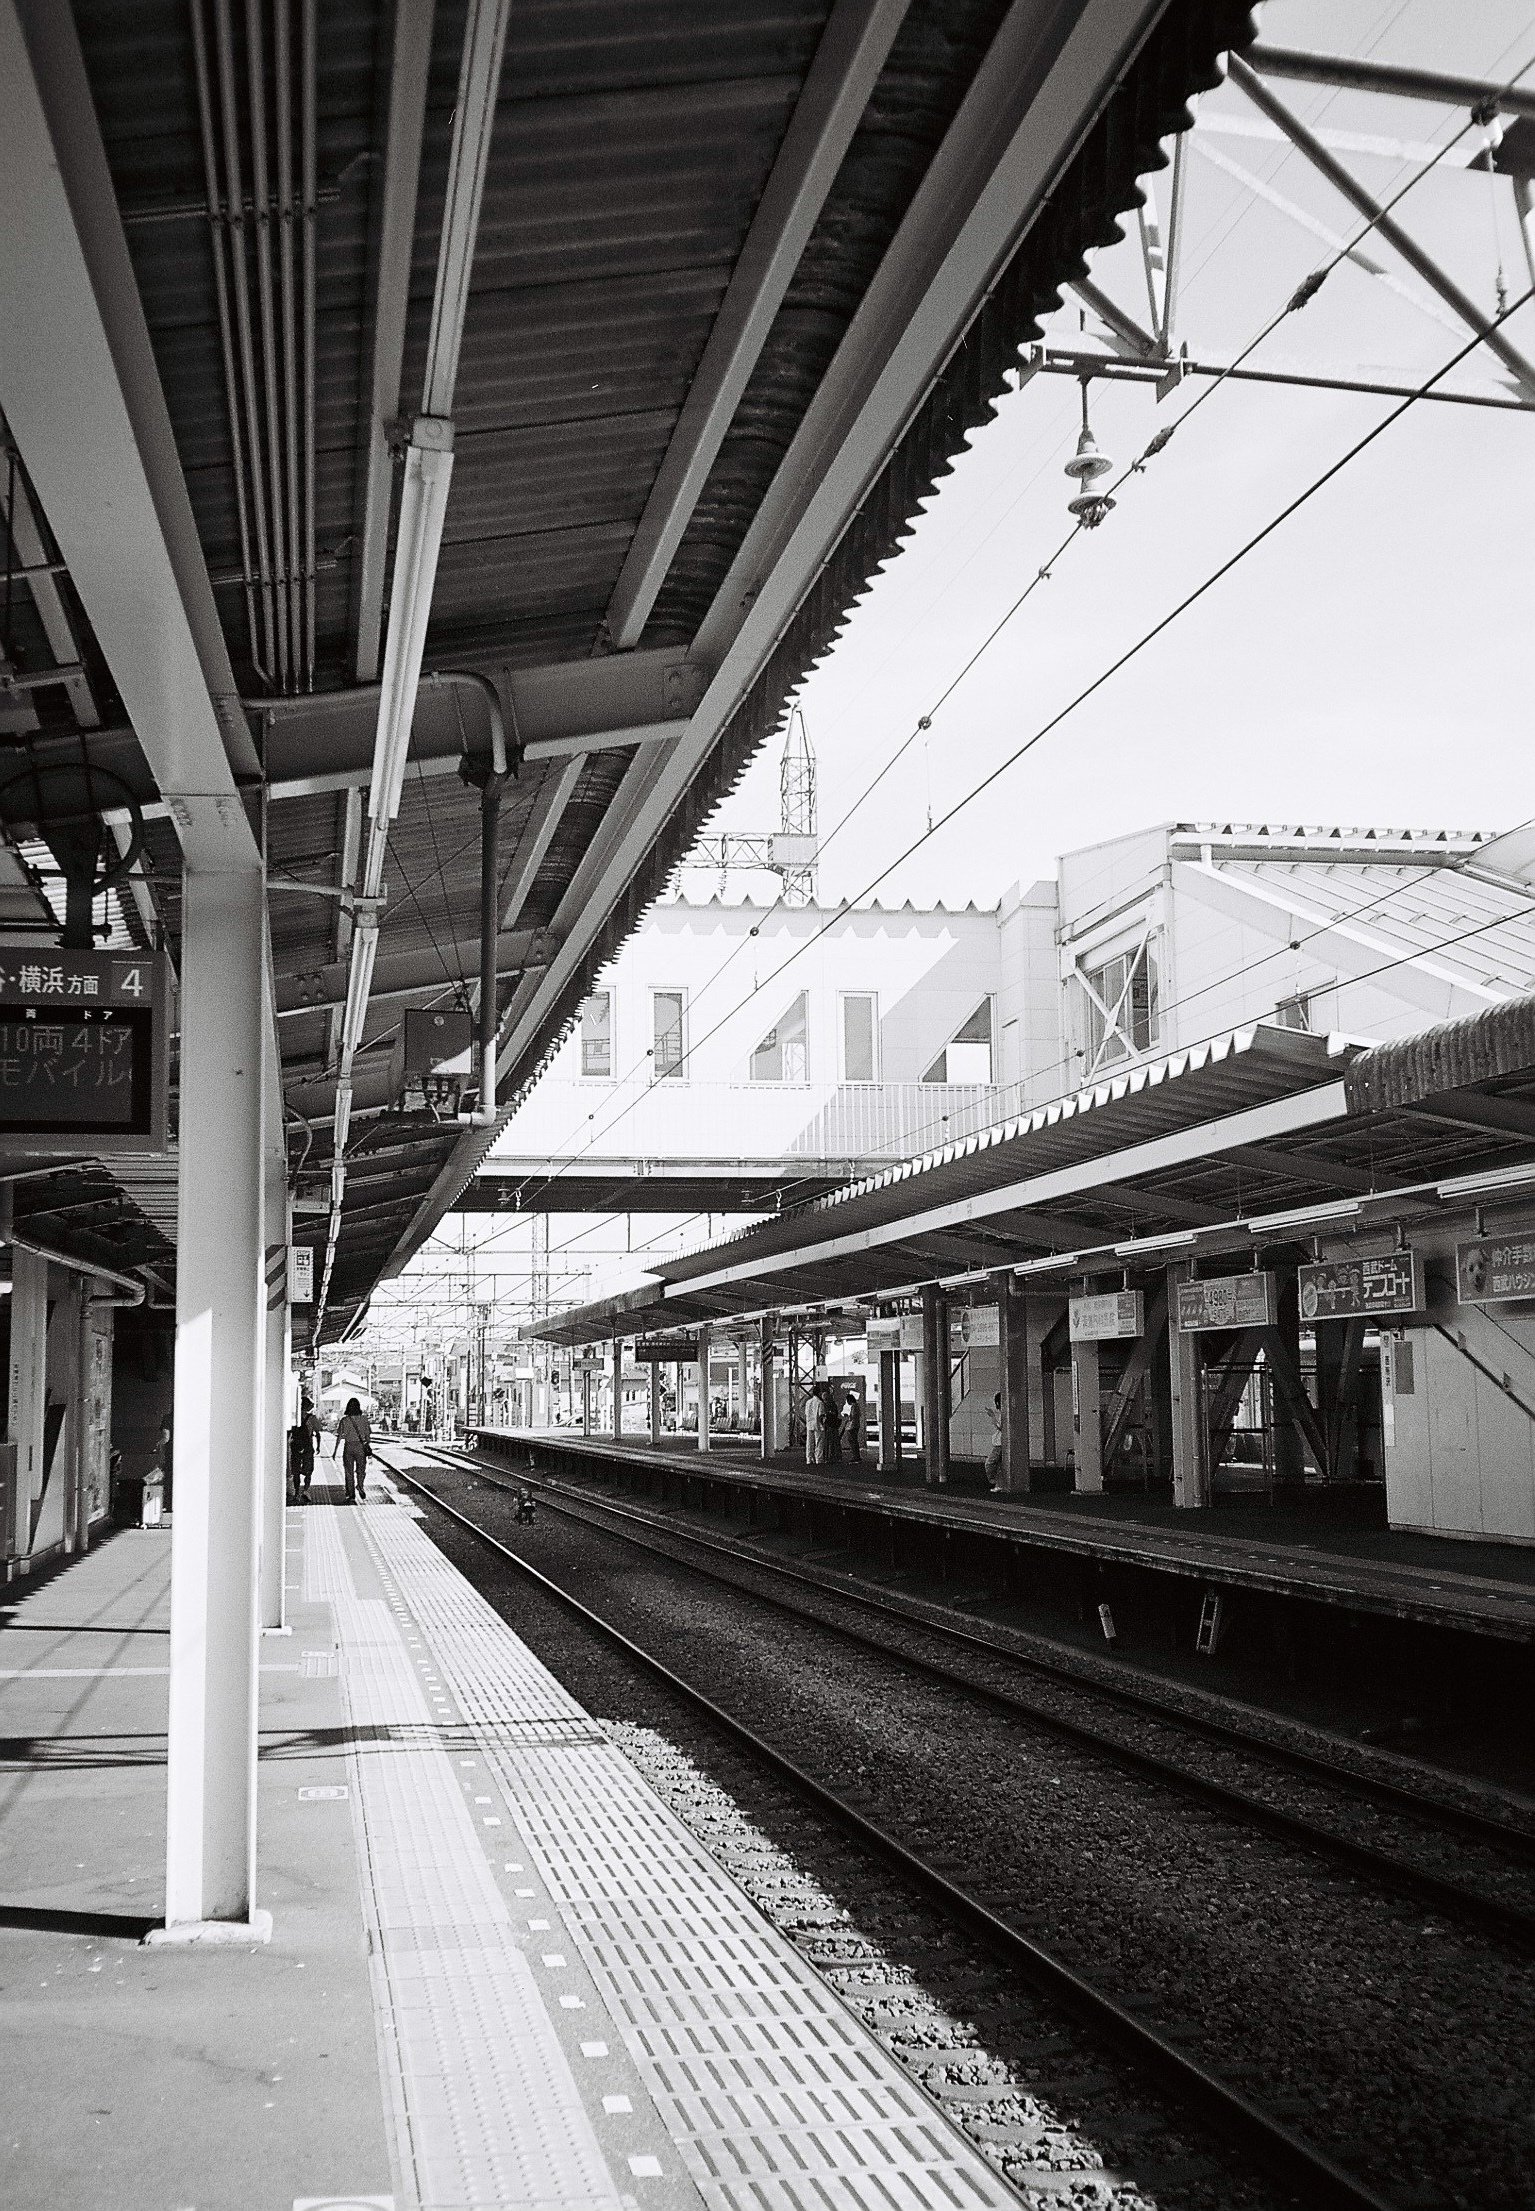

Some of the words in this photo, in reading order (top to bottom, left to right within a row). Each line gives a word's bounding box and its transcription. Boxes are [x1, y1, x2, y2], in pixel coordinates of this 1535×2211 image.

[121, 968, 143, 997] 4
[0, 1058, 132, 1087] モバイル
